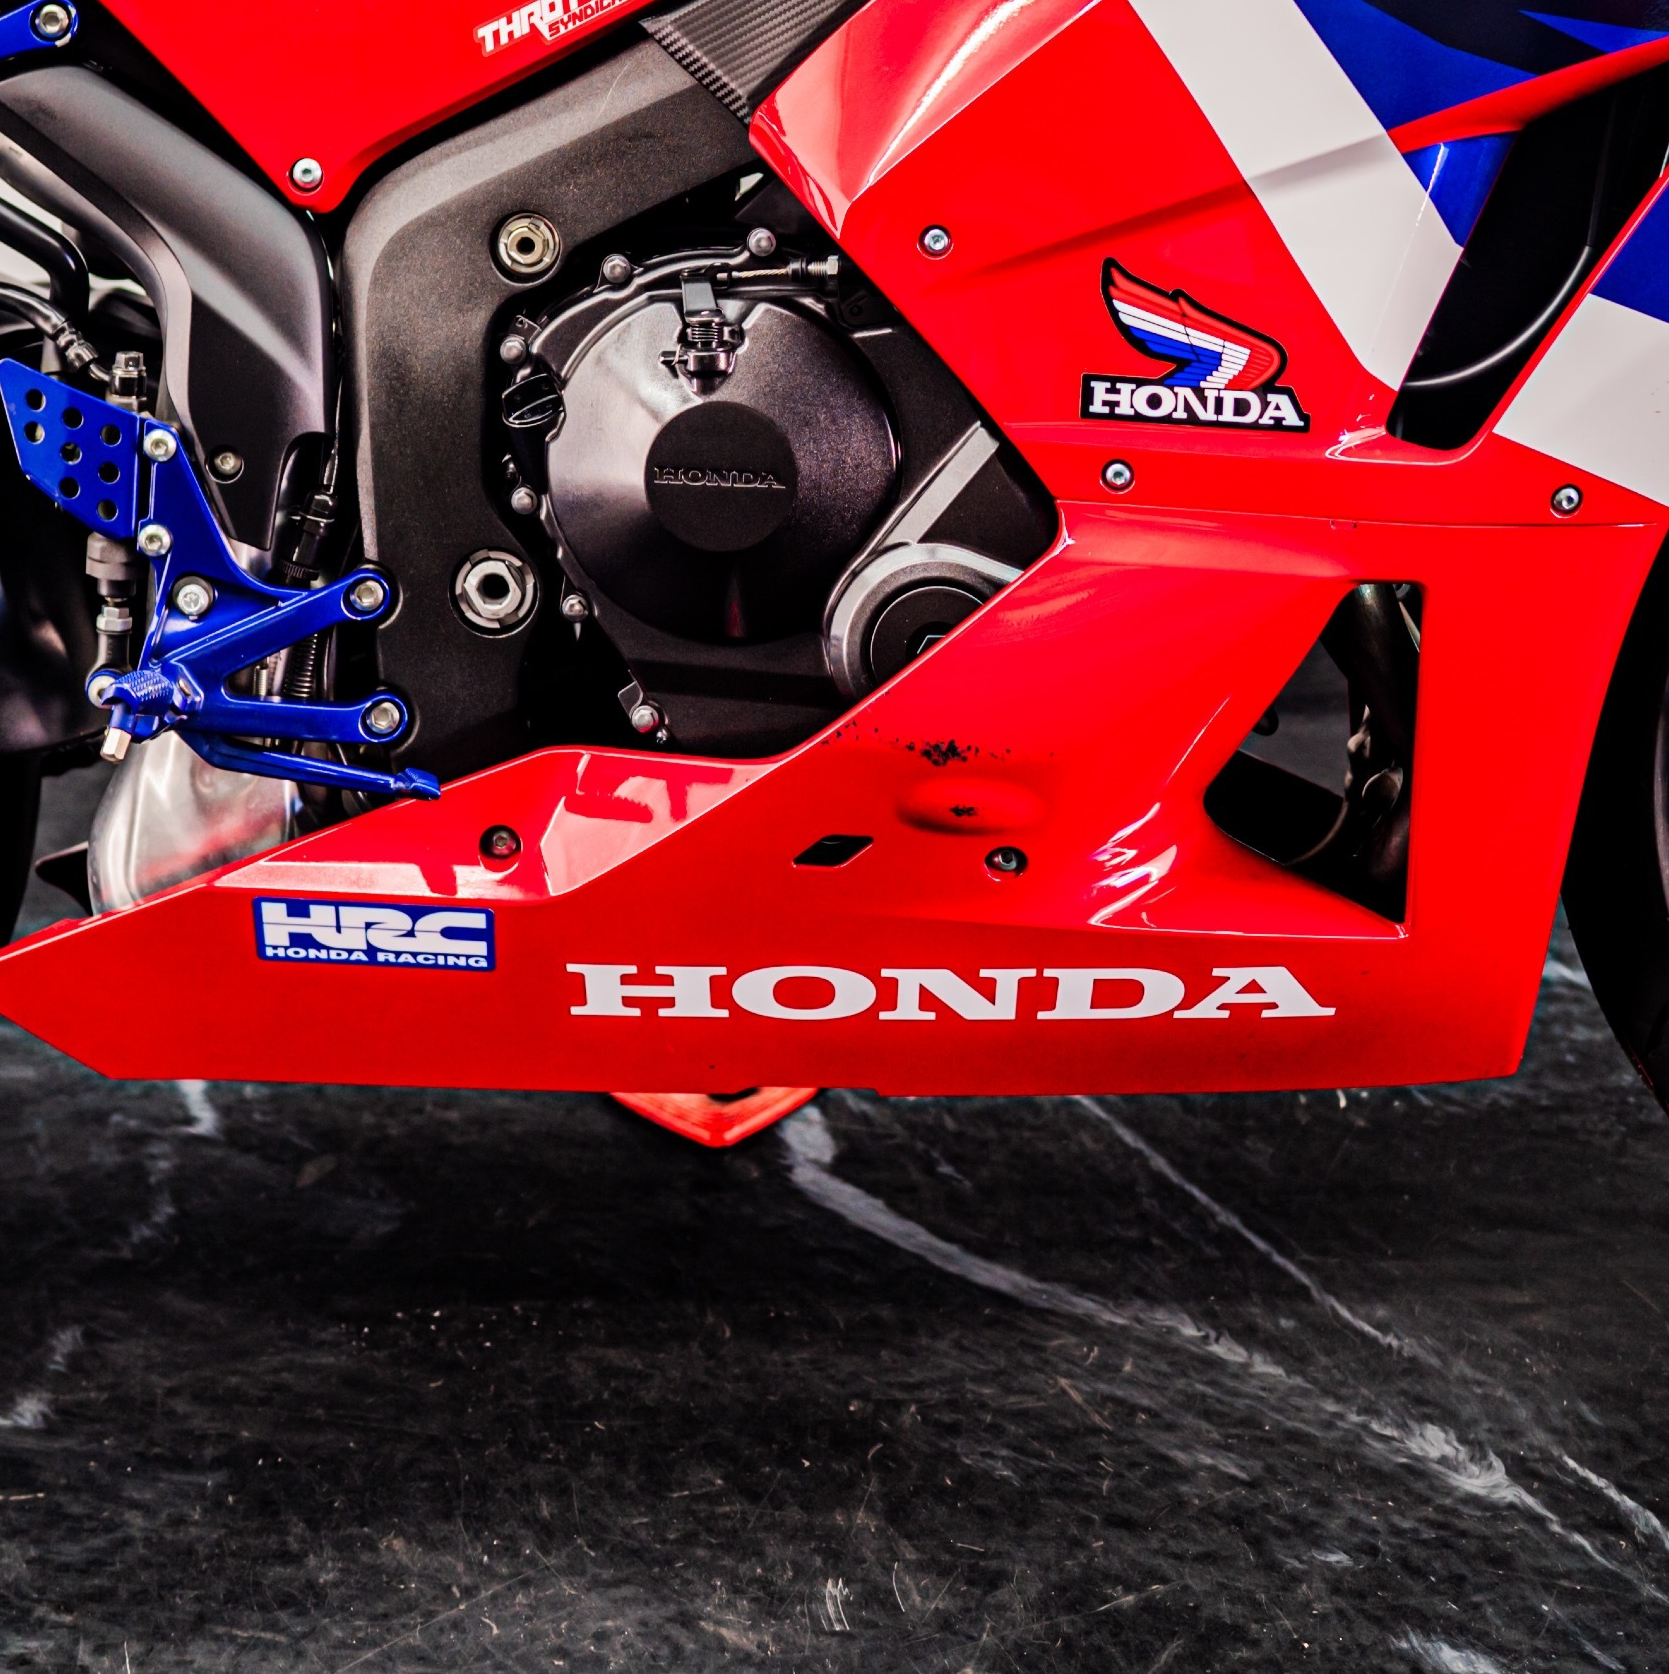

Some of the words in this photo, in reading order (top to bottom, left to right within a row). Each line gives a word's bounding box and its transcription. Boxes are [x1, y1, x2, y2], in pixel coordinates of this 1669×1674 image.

[1089, 381, 1304, 426] HONDA
[654, 467, 786, 489] HONDA
[261, 902, 487, 956] HRC
[265, 946, 368, 961] HONDA
[377, 952, 487, 967] RACING
[566, 963, 1336, 1020] HONDA
